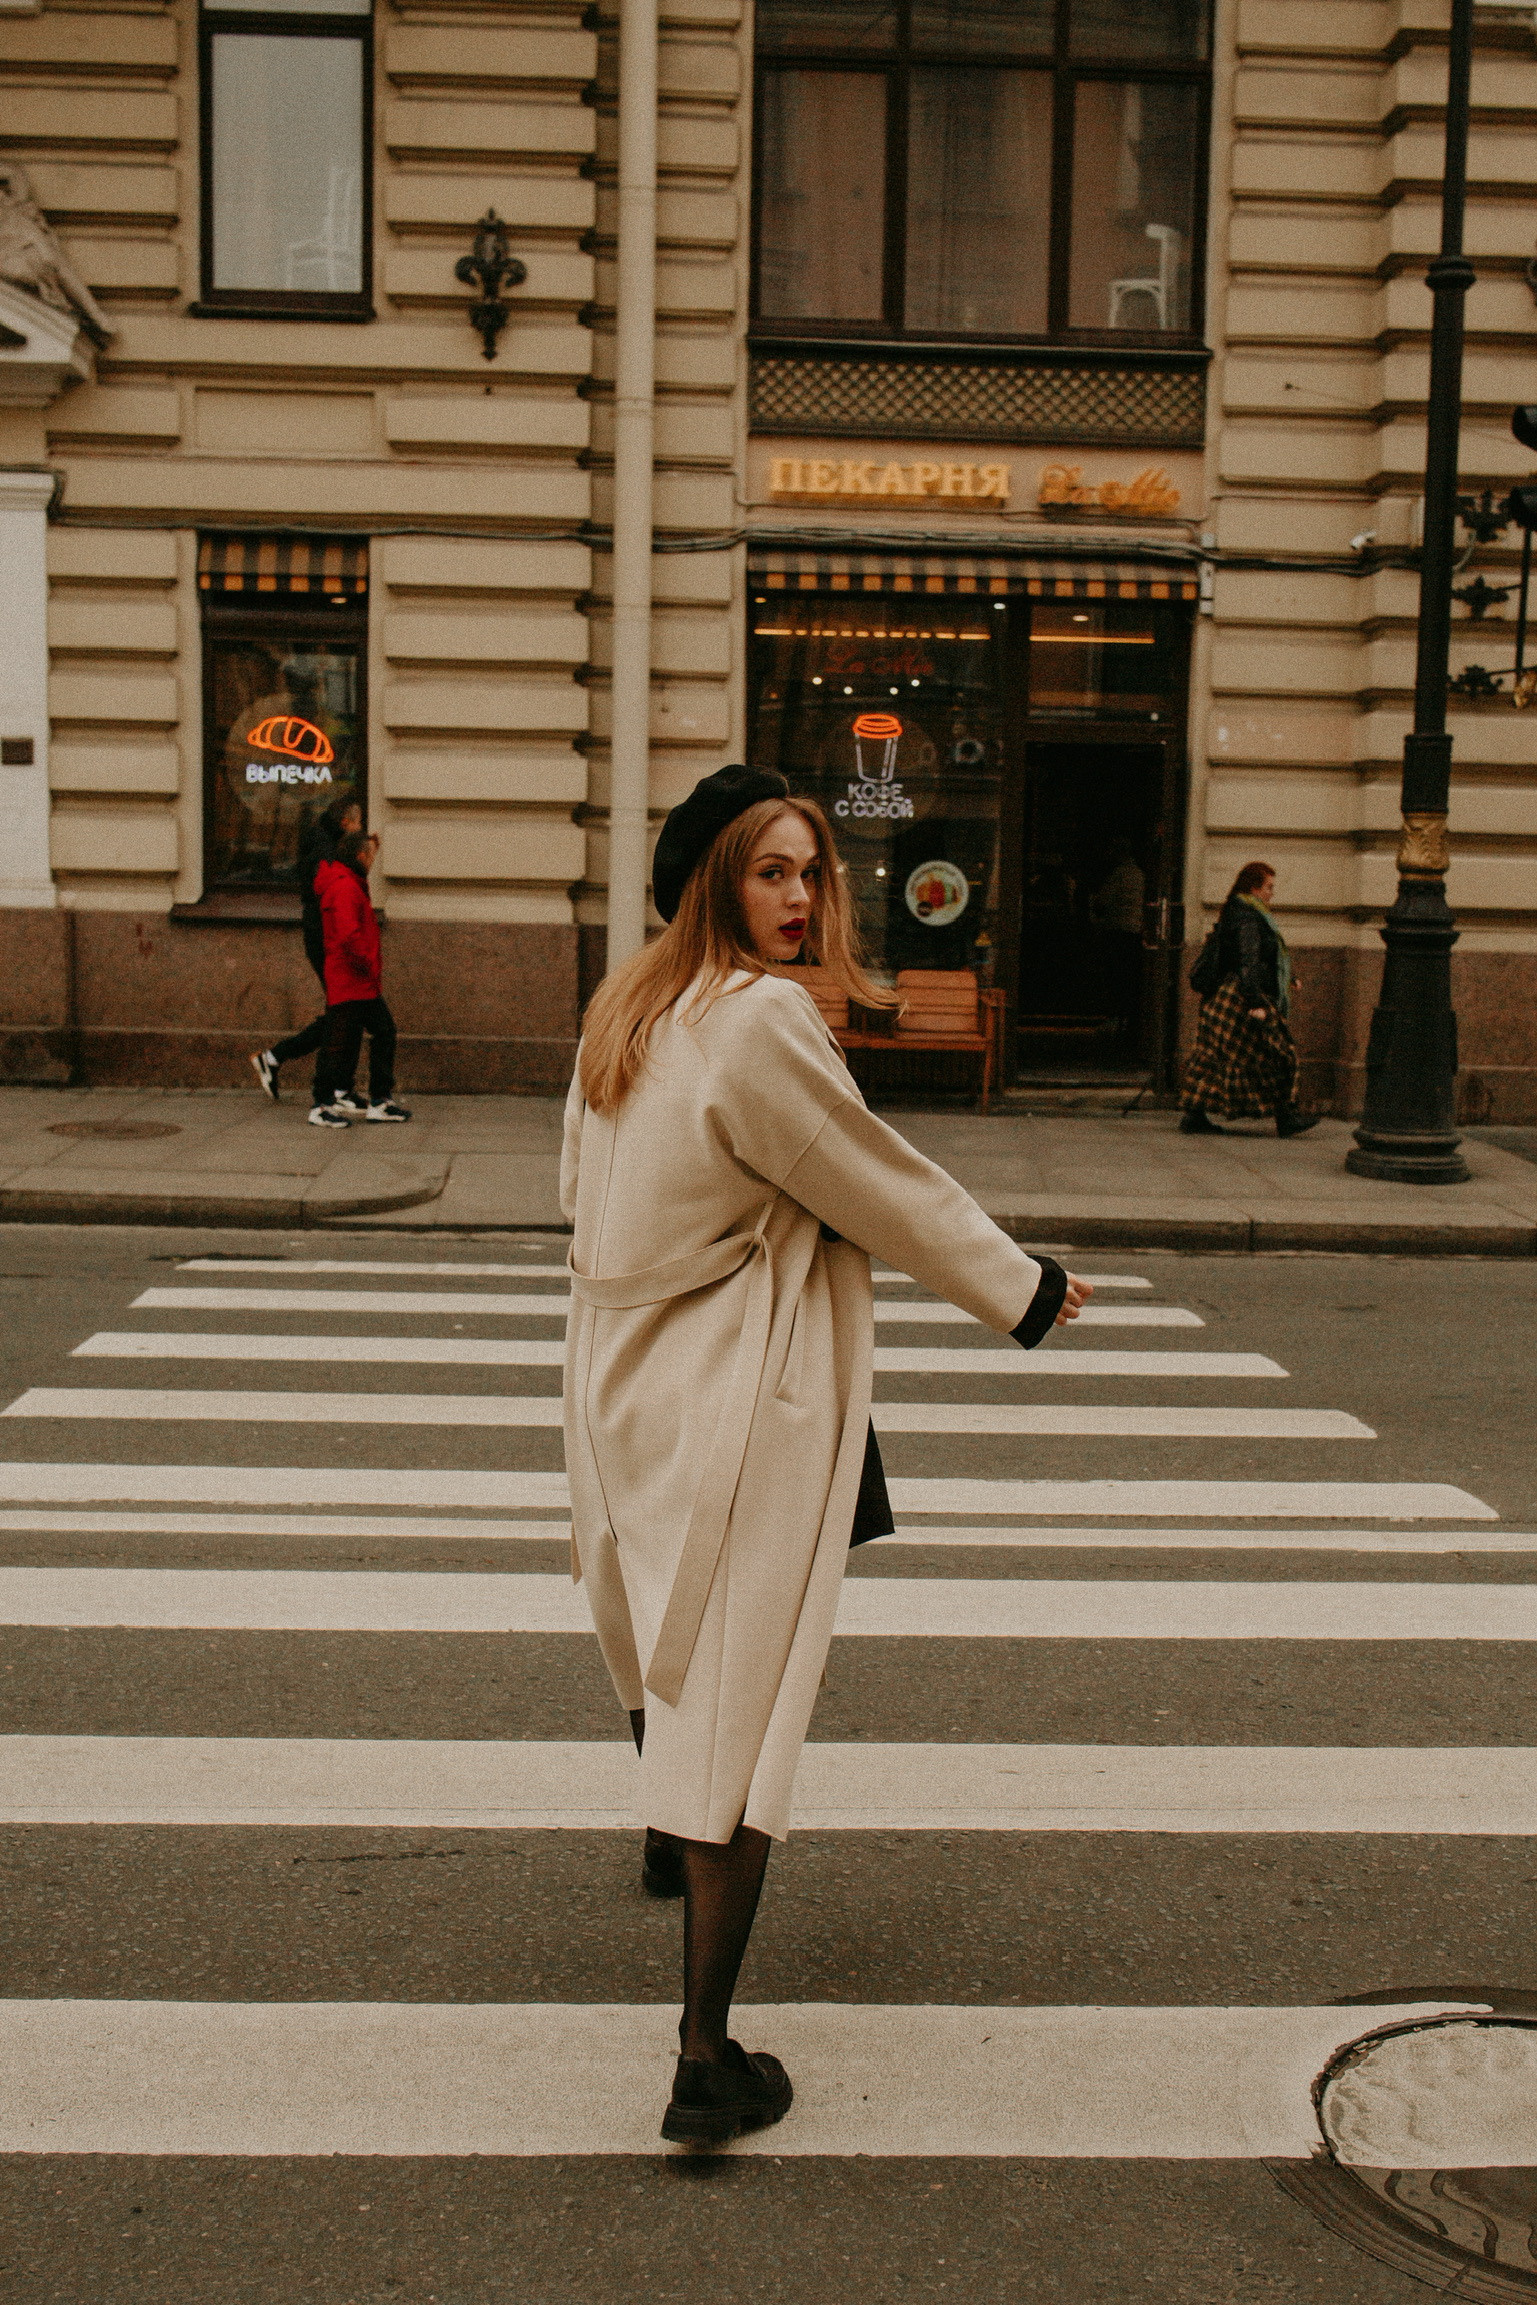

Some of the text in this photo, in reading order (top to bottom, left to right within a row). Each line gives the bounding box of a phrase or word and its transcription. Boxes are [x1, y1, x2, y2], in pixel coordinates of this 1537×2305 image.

[771, 458, 1011, 498] ПЕКАРНЯ
[246, 764, 333, 785] ВЫПЕЧКА
[847, 783, 904, 802] КОФЕ
[834, 798, 914, 819] С СОБОЙ
